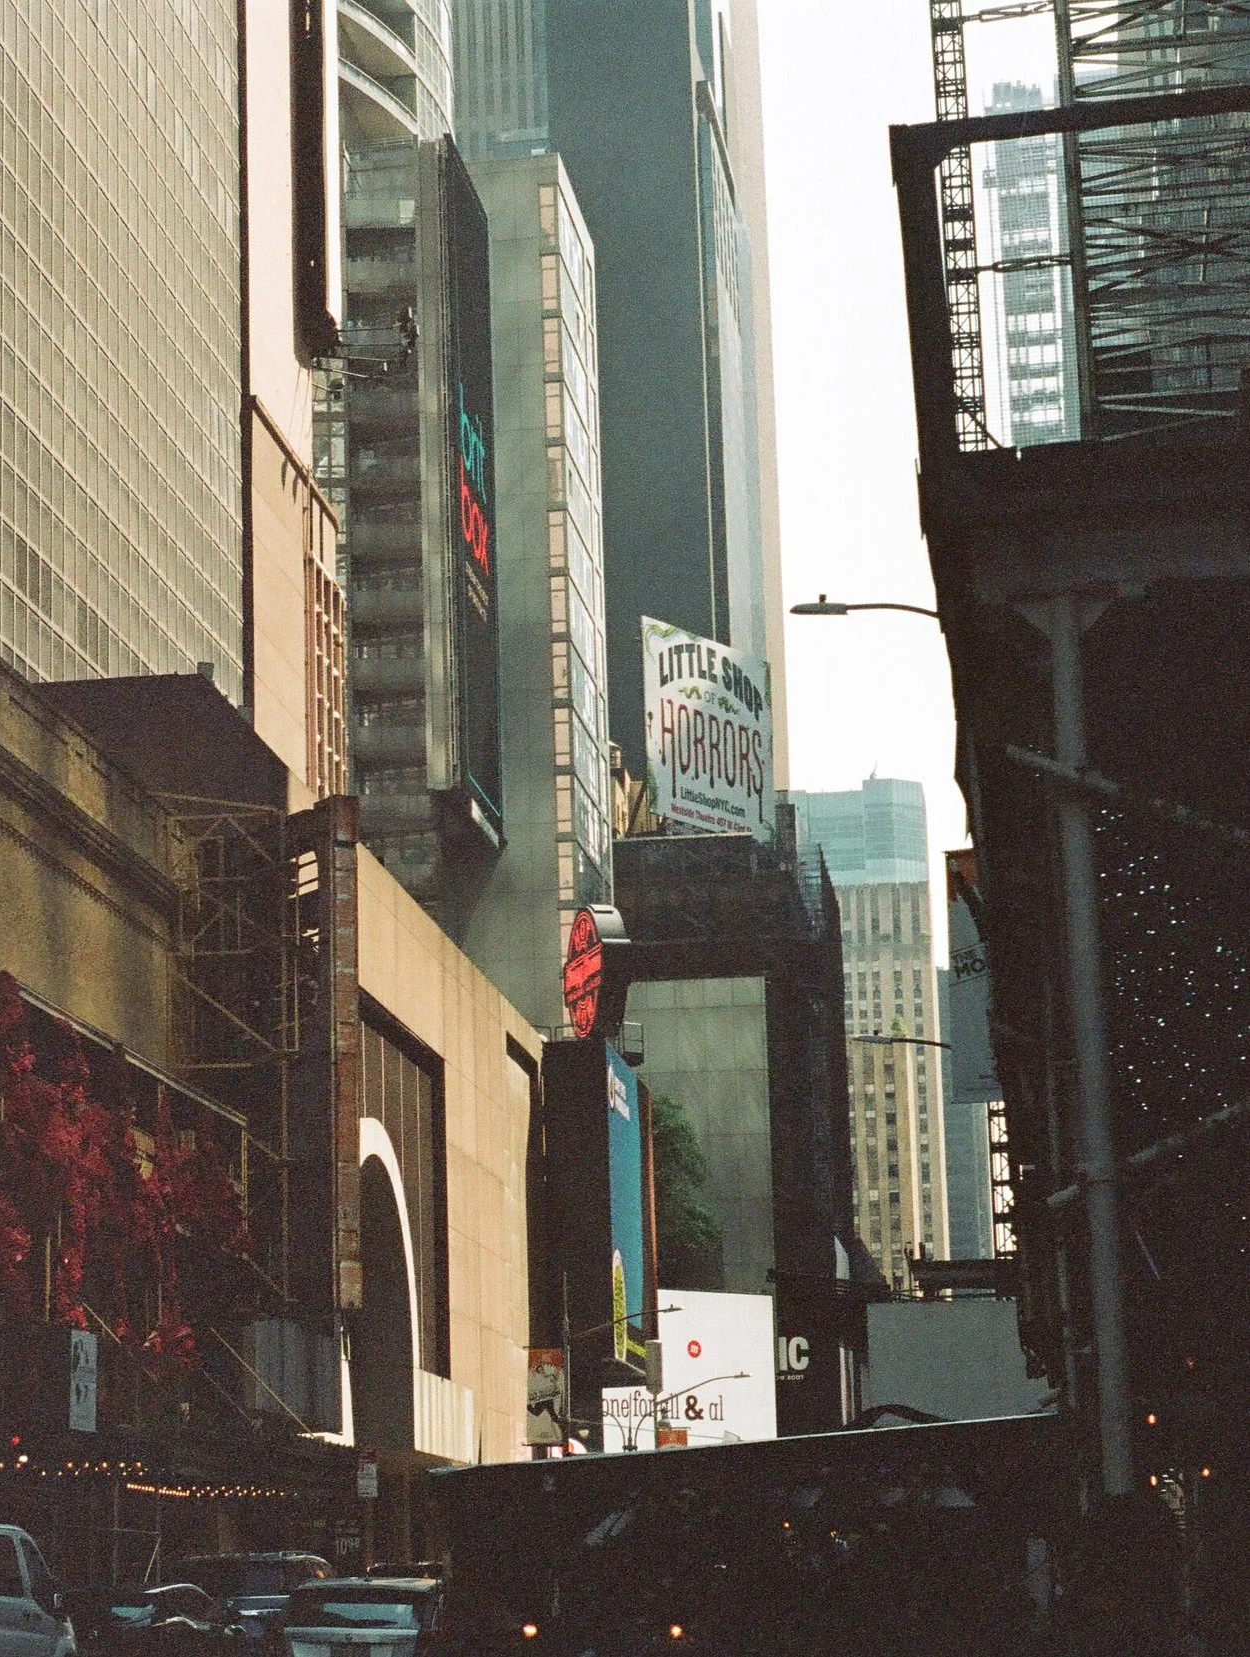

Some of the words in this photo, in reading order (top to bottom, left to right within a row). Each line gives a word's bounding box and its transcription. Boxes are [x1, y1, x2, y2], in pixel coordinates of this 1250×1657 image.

[658, 643, 718, 688] LITTLE
[722, 656, 764, 722] SHOP
[659, 697, 765, 823] HORRORS
[685, 1395, 703, 1421] &
